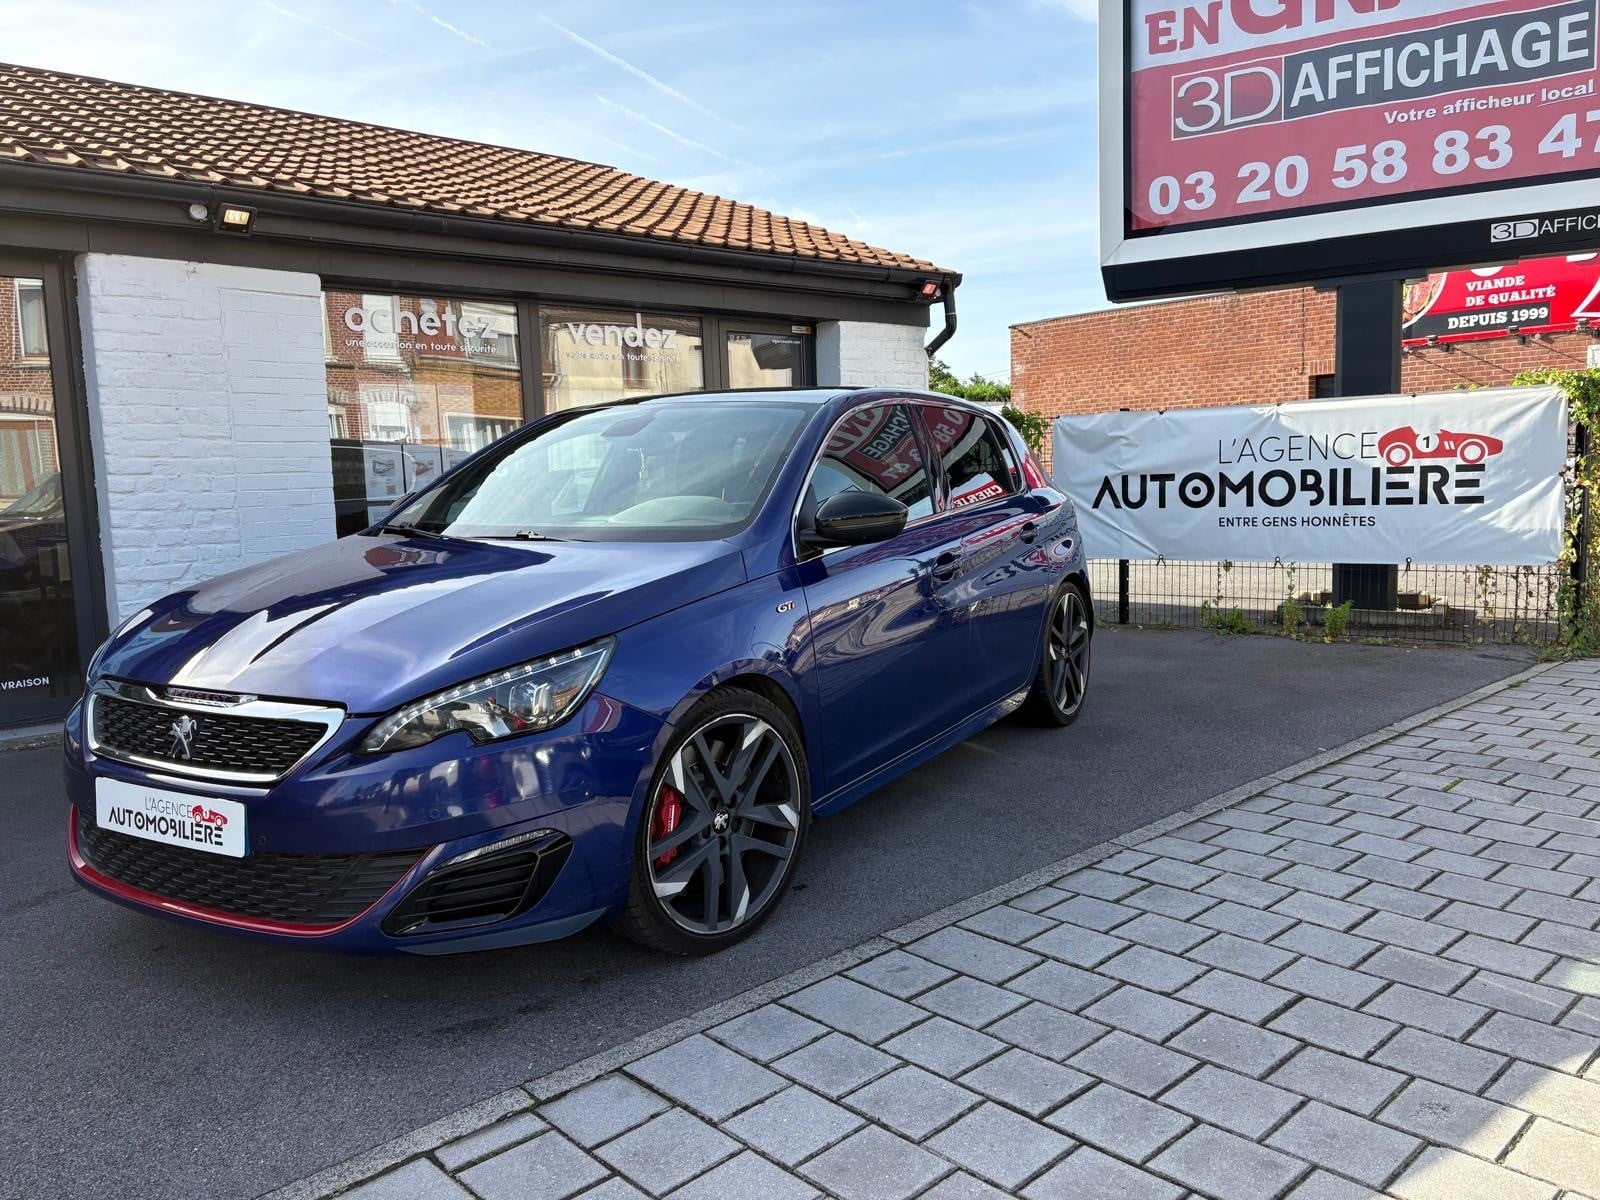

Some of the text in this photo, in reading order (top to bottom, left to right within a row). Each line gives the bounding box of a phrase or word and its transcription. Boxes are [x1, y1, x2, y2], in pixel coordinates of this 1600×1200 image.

[1144, 0, 1223, 55] EN
[1175, 66, 1282, 132] 3D
[1290, 12, 1590, 107] AFFICHAGE
[1384, 79, 1595, 125] Votre afficheur local
[1148, 170, 1217, 216] 03
[1236, 155, 1310, 204] 20
[1331, 139, 1409, 189] 58
[1432, 124, 1513, 175] 83
[1491, 214, 1600, 242] 3D AFFIC
[1465, 275, 1525, 292] VIANDE
[1465, 284, 1556, 307] DE QUALITÉ
[344, 301, 499, 339] achetez
[567, 312, 677, 349] vendez
[1447, 306, 1549, 330] DEPUIS 1999
[346, 338, 364, 348] une
[415, 342, 428, 351] en
[430, 341, 456, 352] toute
[627, 353, 648, 362] toute
[1218, 430, 1379, 464] L'AGENCE
[1218, 512, 1376, 528] ENTRE GENS HONNÊTES
[144, 796, 193, 819] L'AGENCE
